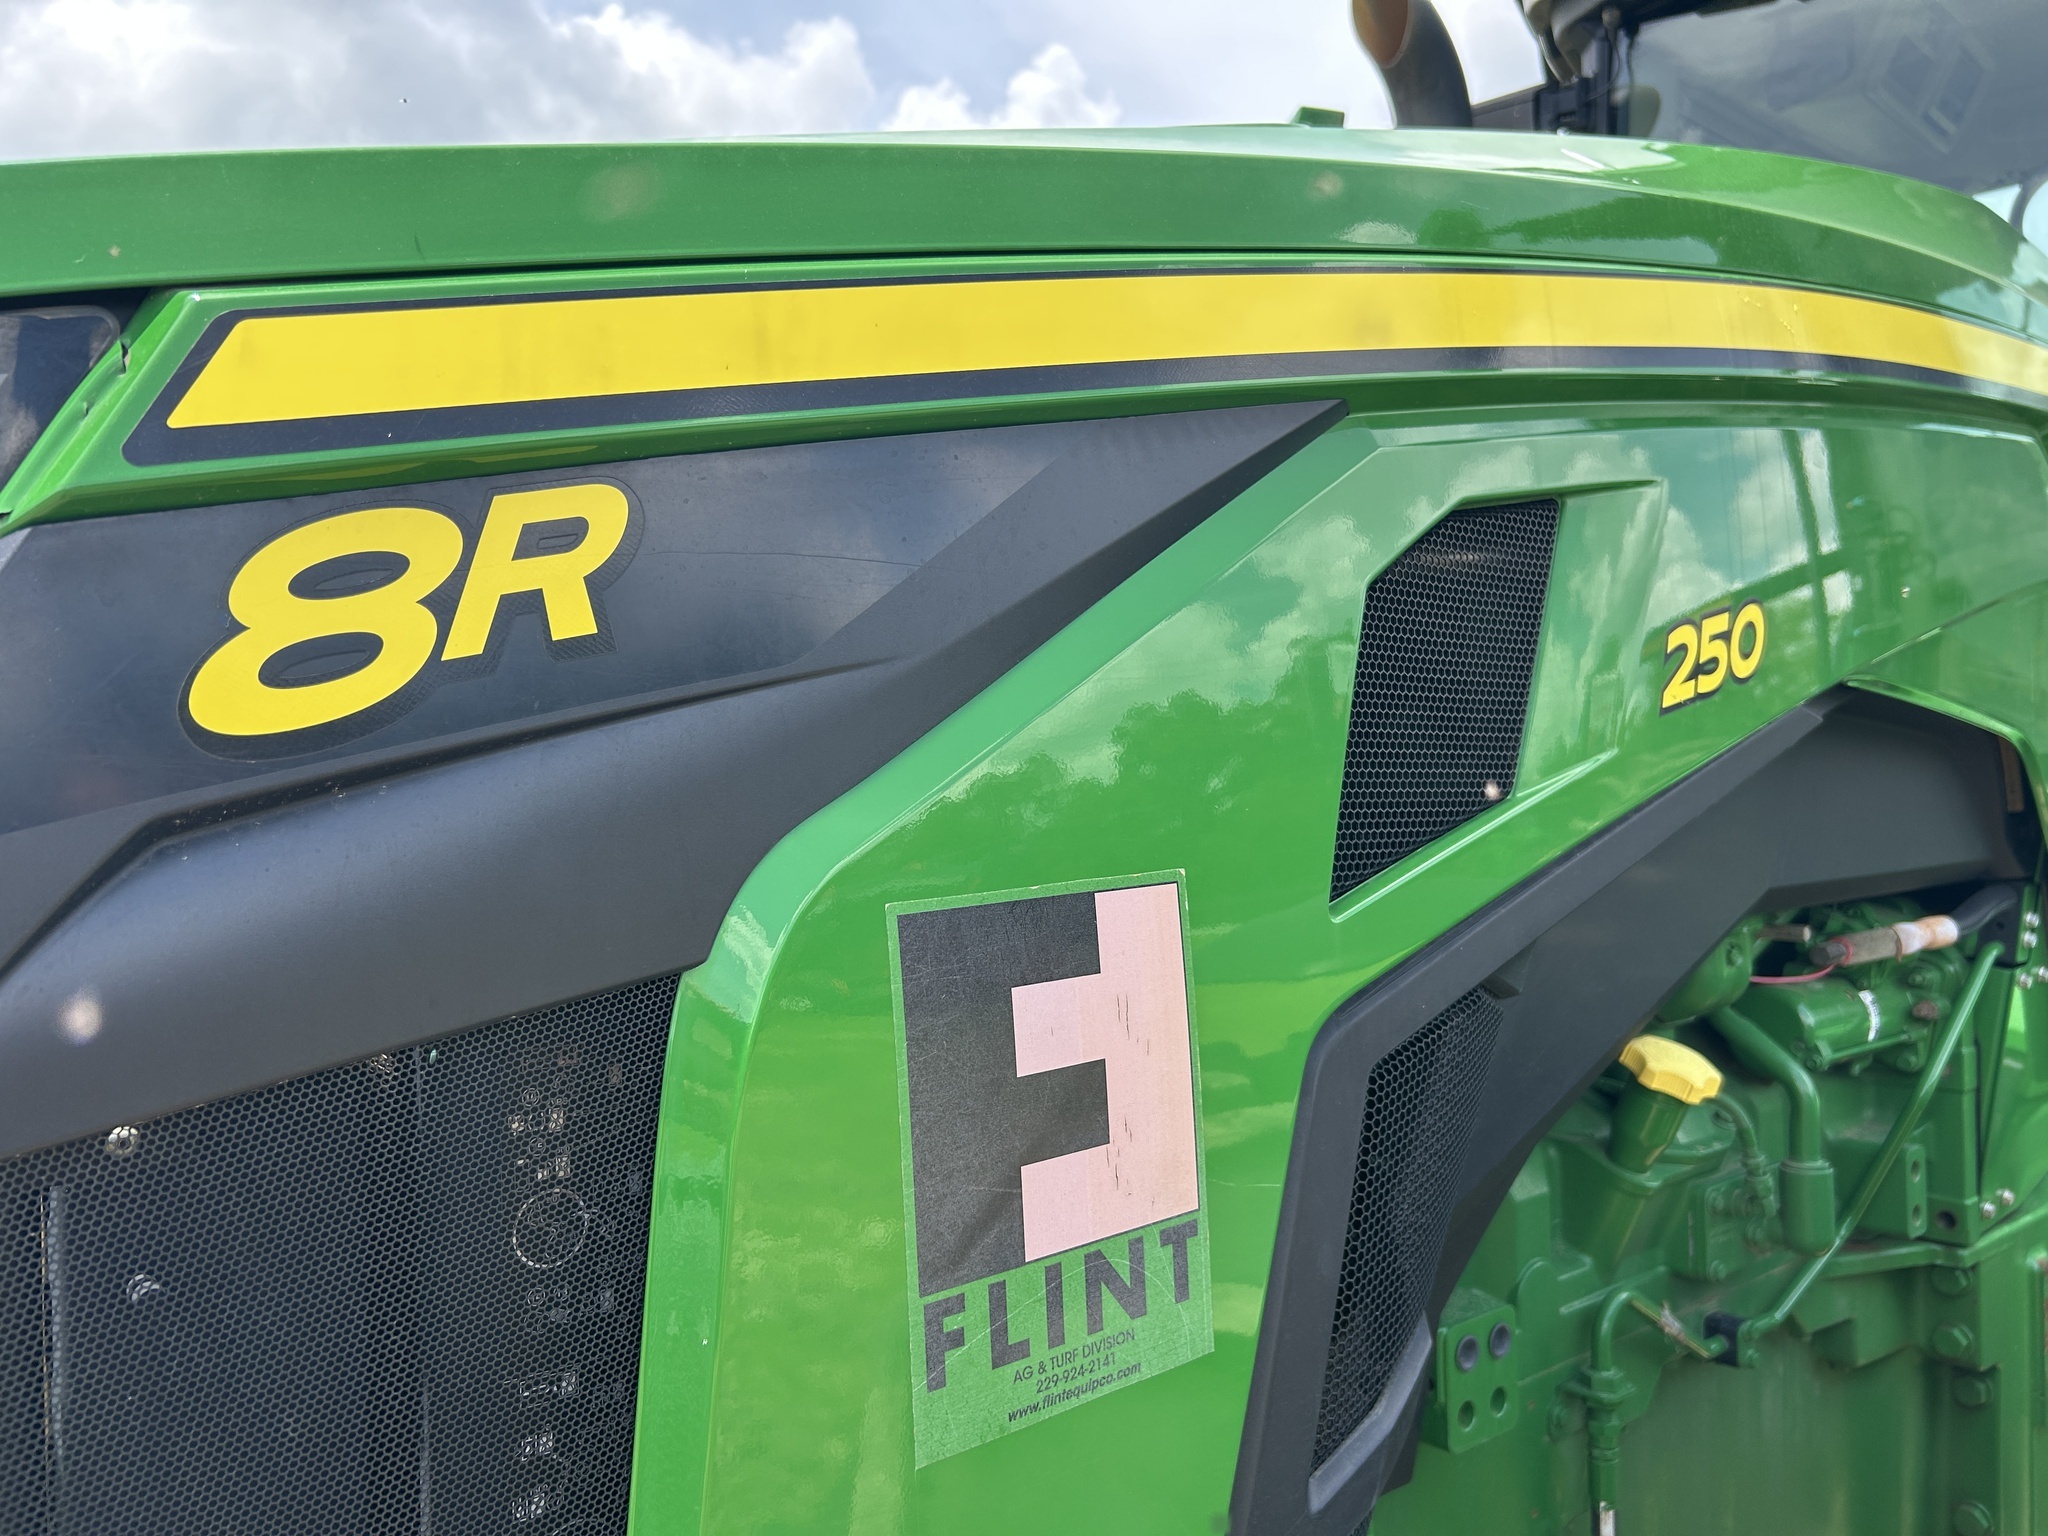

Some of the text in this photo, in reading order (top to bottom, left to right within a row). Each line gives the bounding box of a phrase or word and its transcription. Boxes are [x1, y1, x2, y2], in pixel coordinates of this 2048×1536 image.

[188, 483, 629, 736] 8R
[1661, 601, 1765, 711] 250
[923, 1219, 1199, 1393] FLINT
[1008, 1362, 1141, 1422] www.flintequipco.com
[1013, 1327, 1136, 1385] AG & TURF DIVISION
[1036, 1351, 1117, 1394] 229-924-2141
